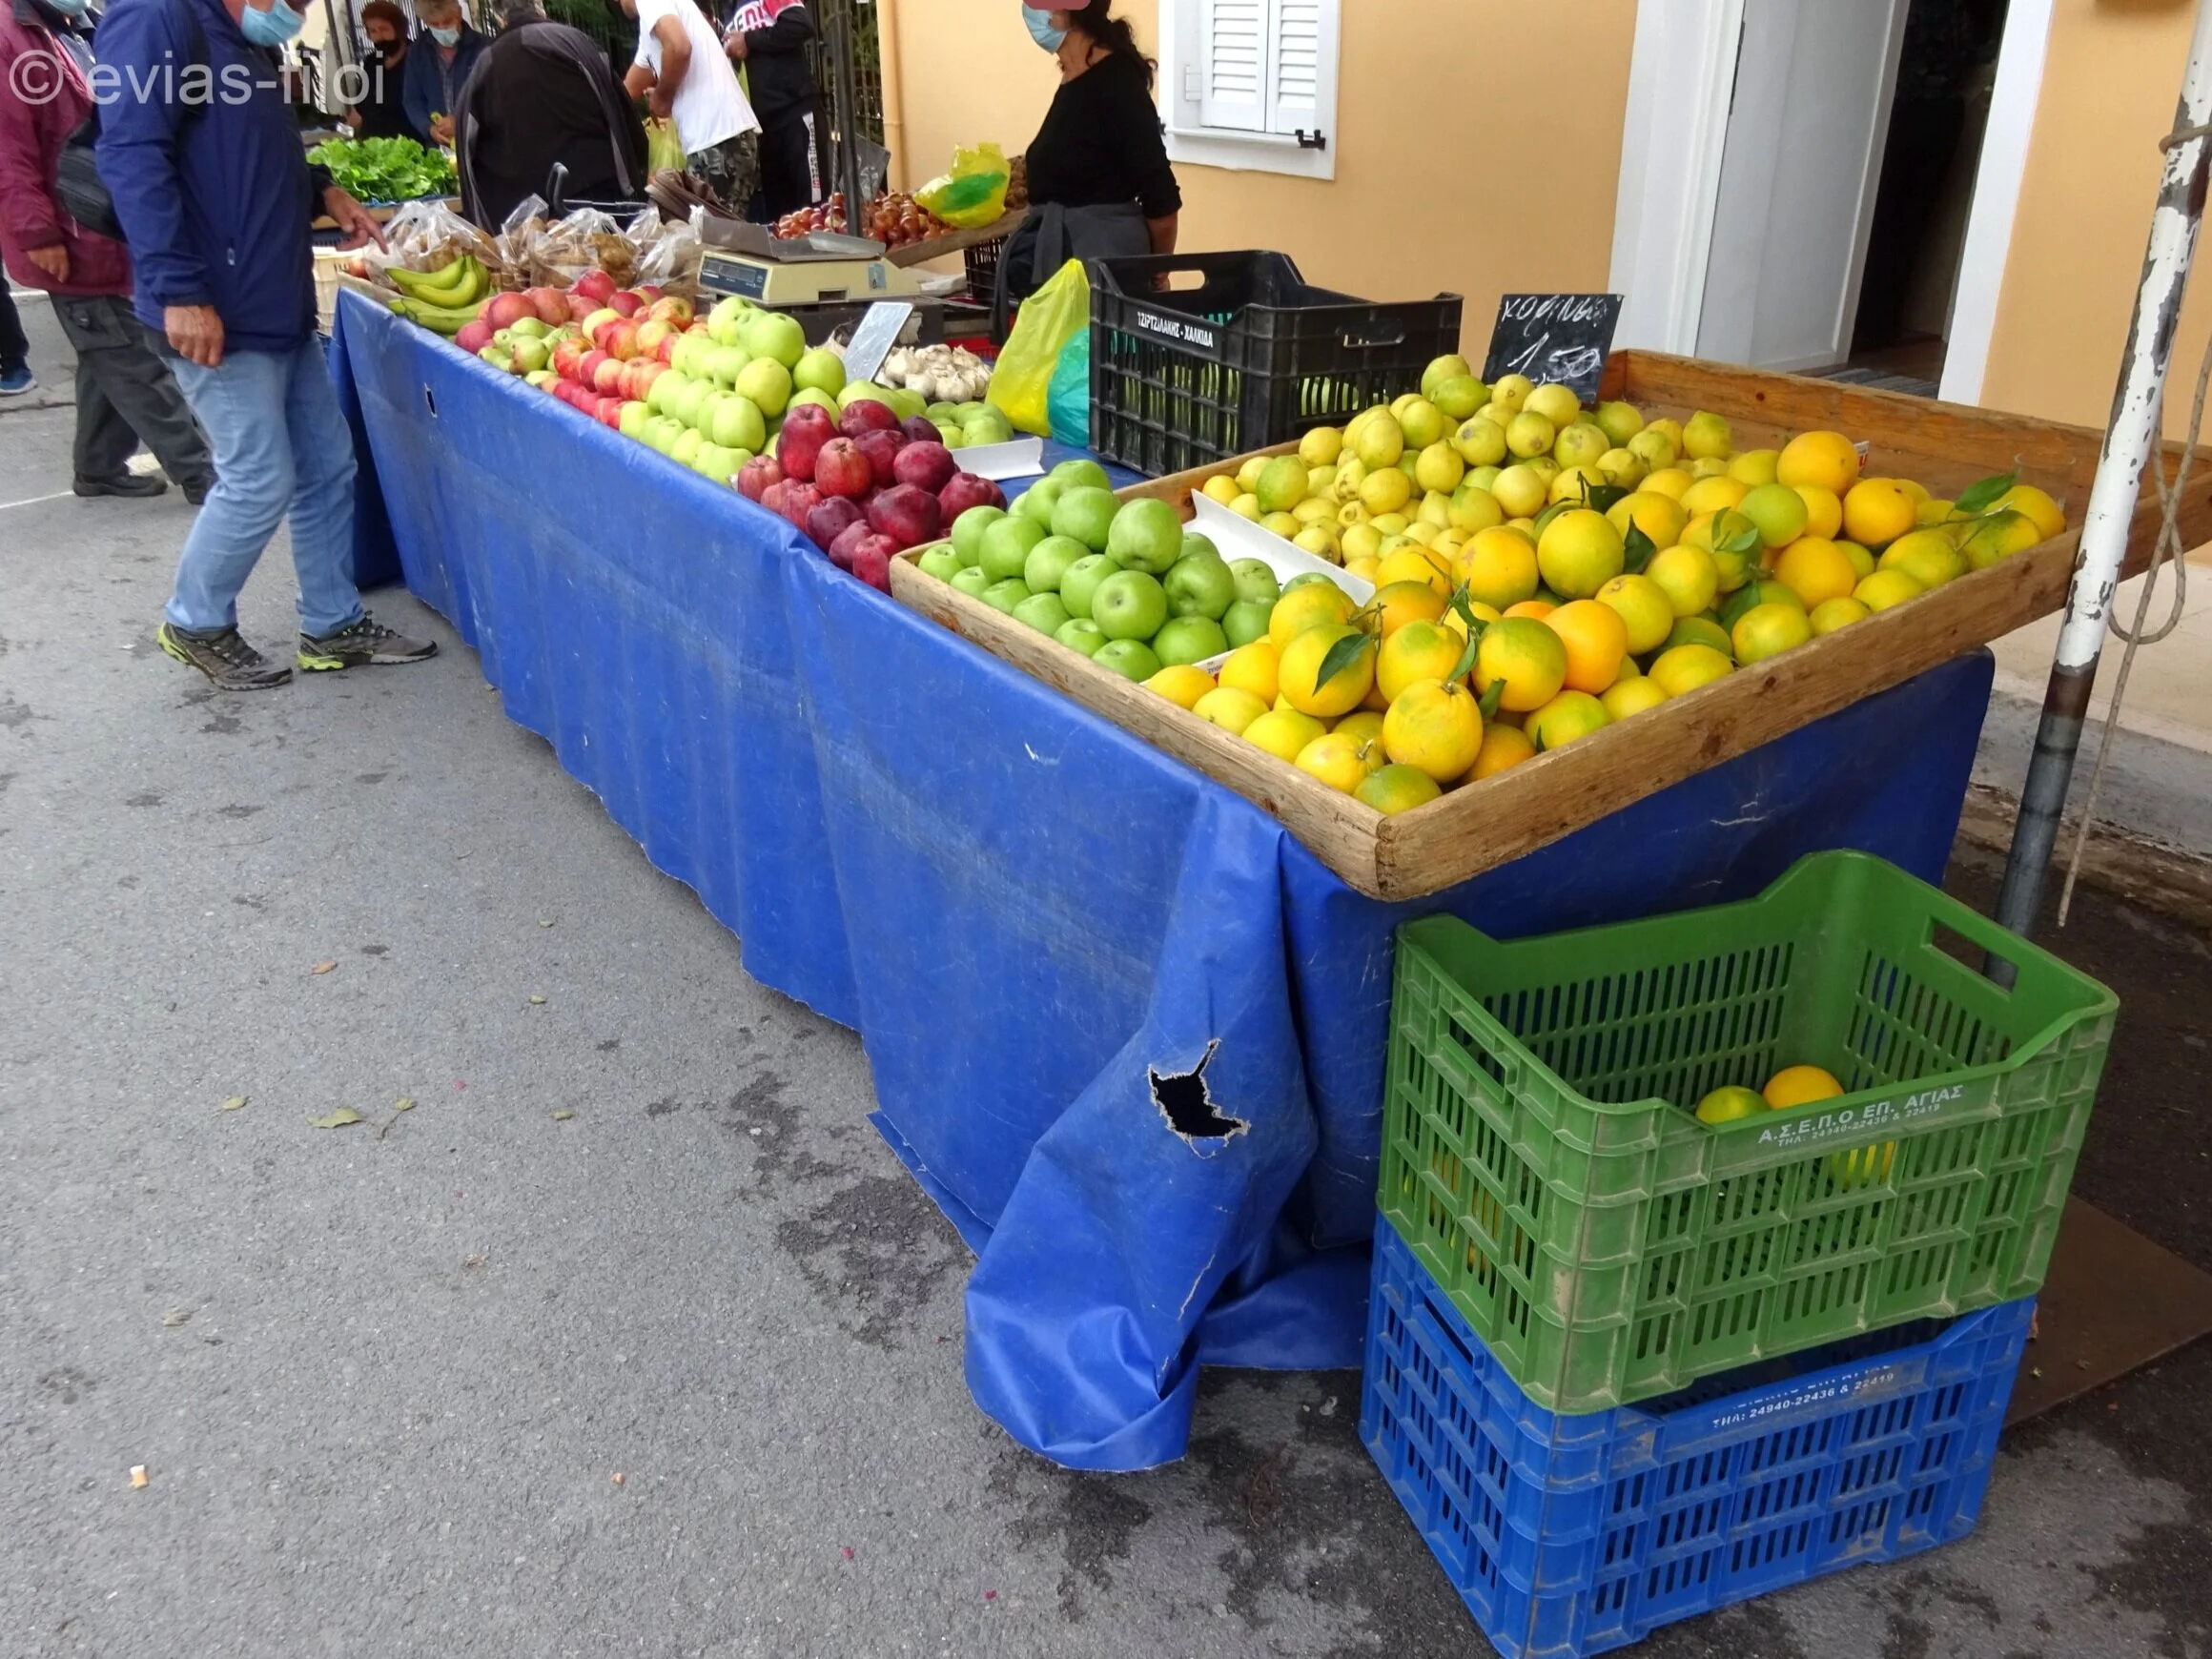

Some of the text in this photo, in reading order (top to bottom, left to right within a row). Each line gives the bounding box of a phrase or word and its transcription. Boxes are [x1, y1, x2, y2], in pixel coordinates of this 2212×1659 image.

[1183, 325, 1214, 348] ΧΑΛΚΙΔΑ
[1863, 1100, 1895, 1119] ΕΠ.
[1904, 1084, 1964, 1110] ΑΓΙΑΣ
[1749, 1386, 1835, 1419] 24940-22436
[1839, 1383, 1849, 1394] &
